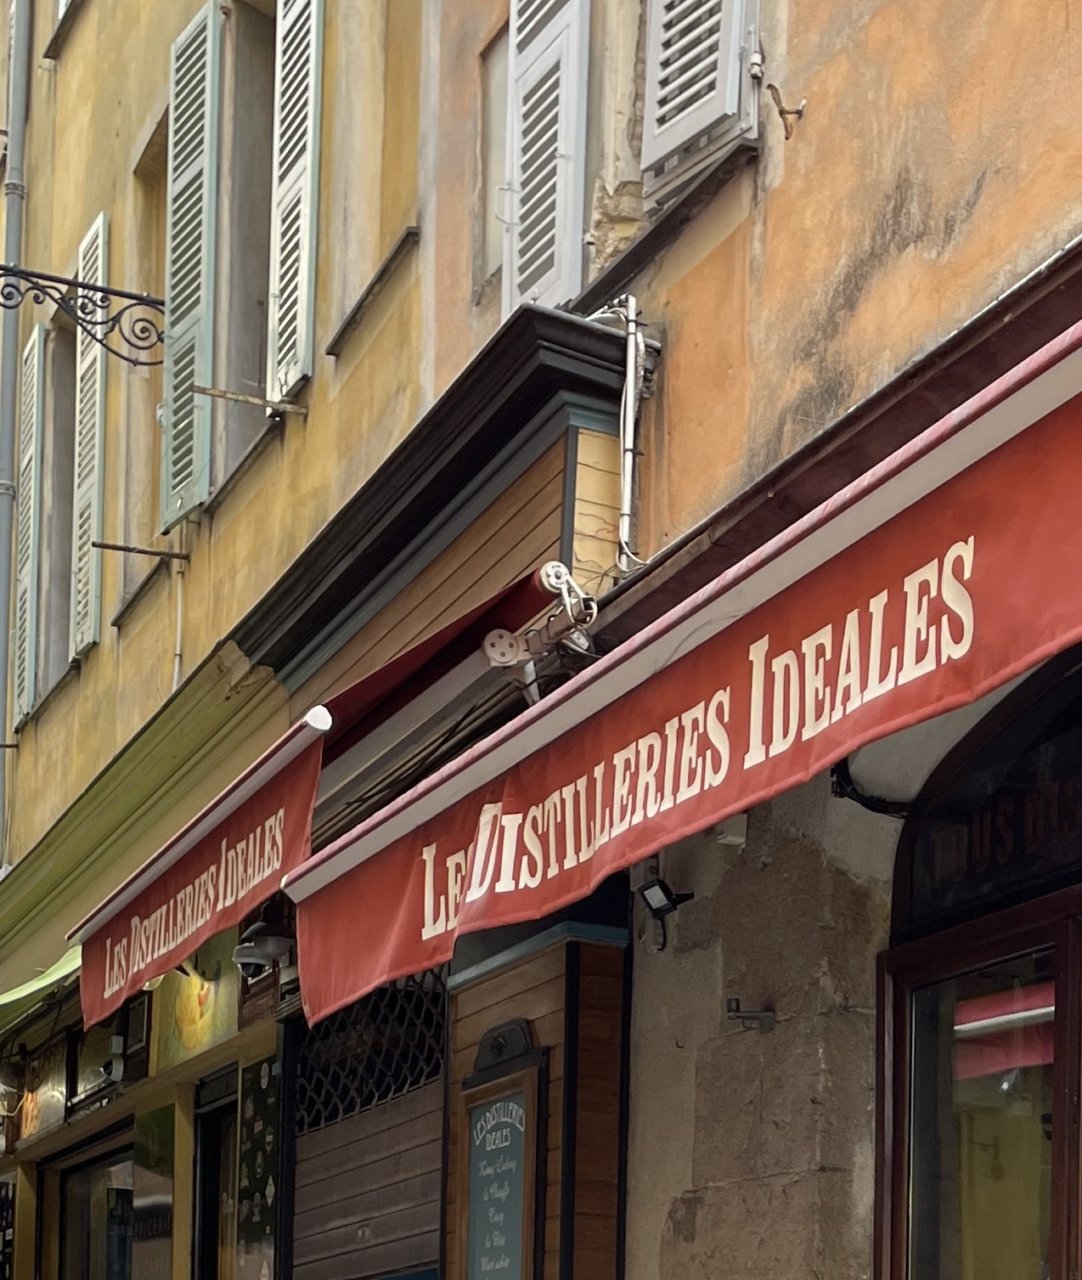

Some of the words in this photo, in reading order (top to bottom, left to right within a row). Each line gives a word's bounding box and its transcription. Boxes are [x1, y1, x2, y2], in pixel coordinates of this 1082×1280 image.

[422, 842, 475, 941] LE
[465, 684, 731, 904] DISTILLERIES
[743, 535, 975, 770] IDEALES
[104, 937, 127, 999] LES
[216, 807, 285, 912] IDEALES
